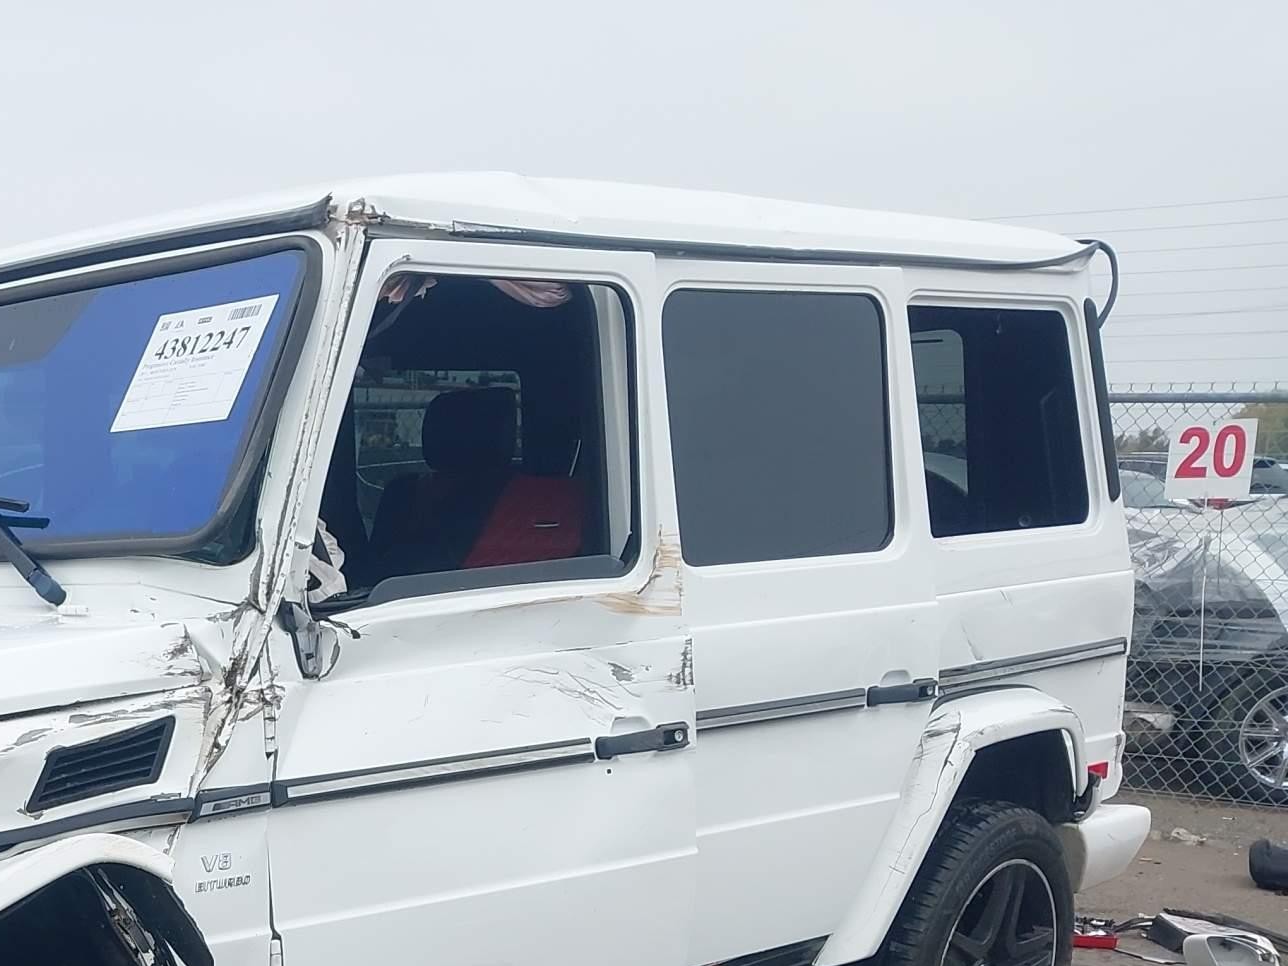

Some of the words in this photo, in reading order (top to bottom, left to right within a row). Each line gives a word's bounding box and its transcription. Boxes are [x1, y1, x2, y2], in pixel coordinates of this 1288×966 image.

[154, 326, 252, 361] 43812247
[1175, 425, 1247, 479] 20
[201, 852, 233, 873] V8
